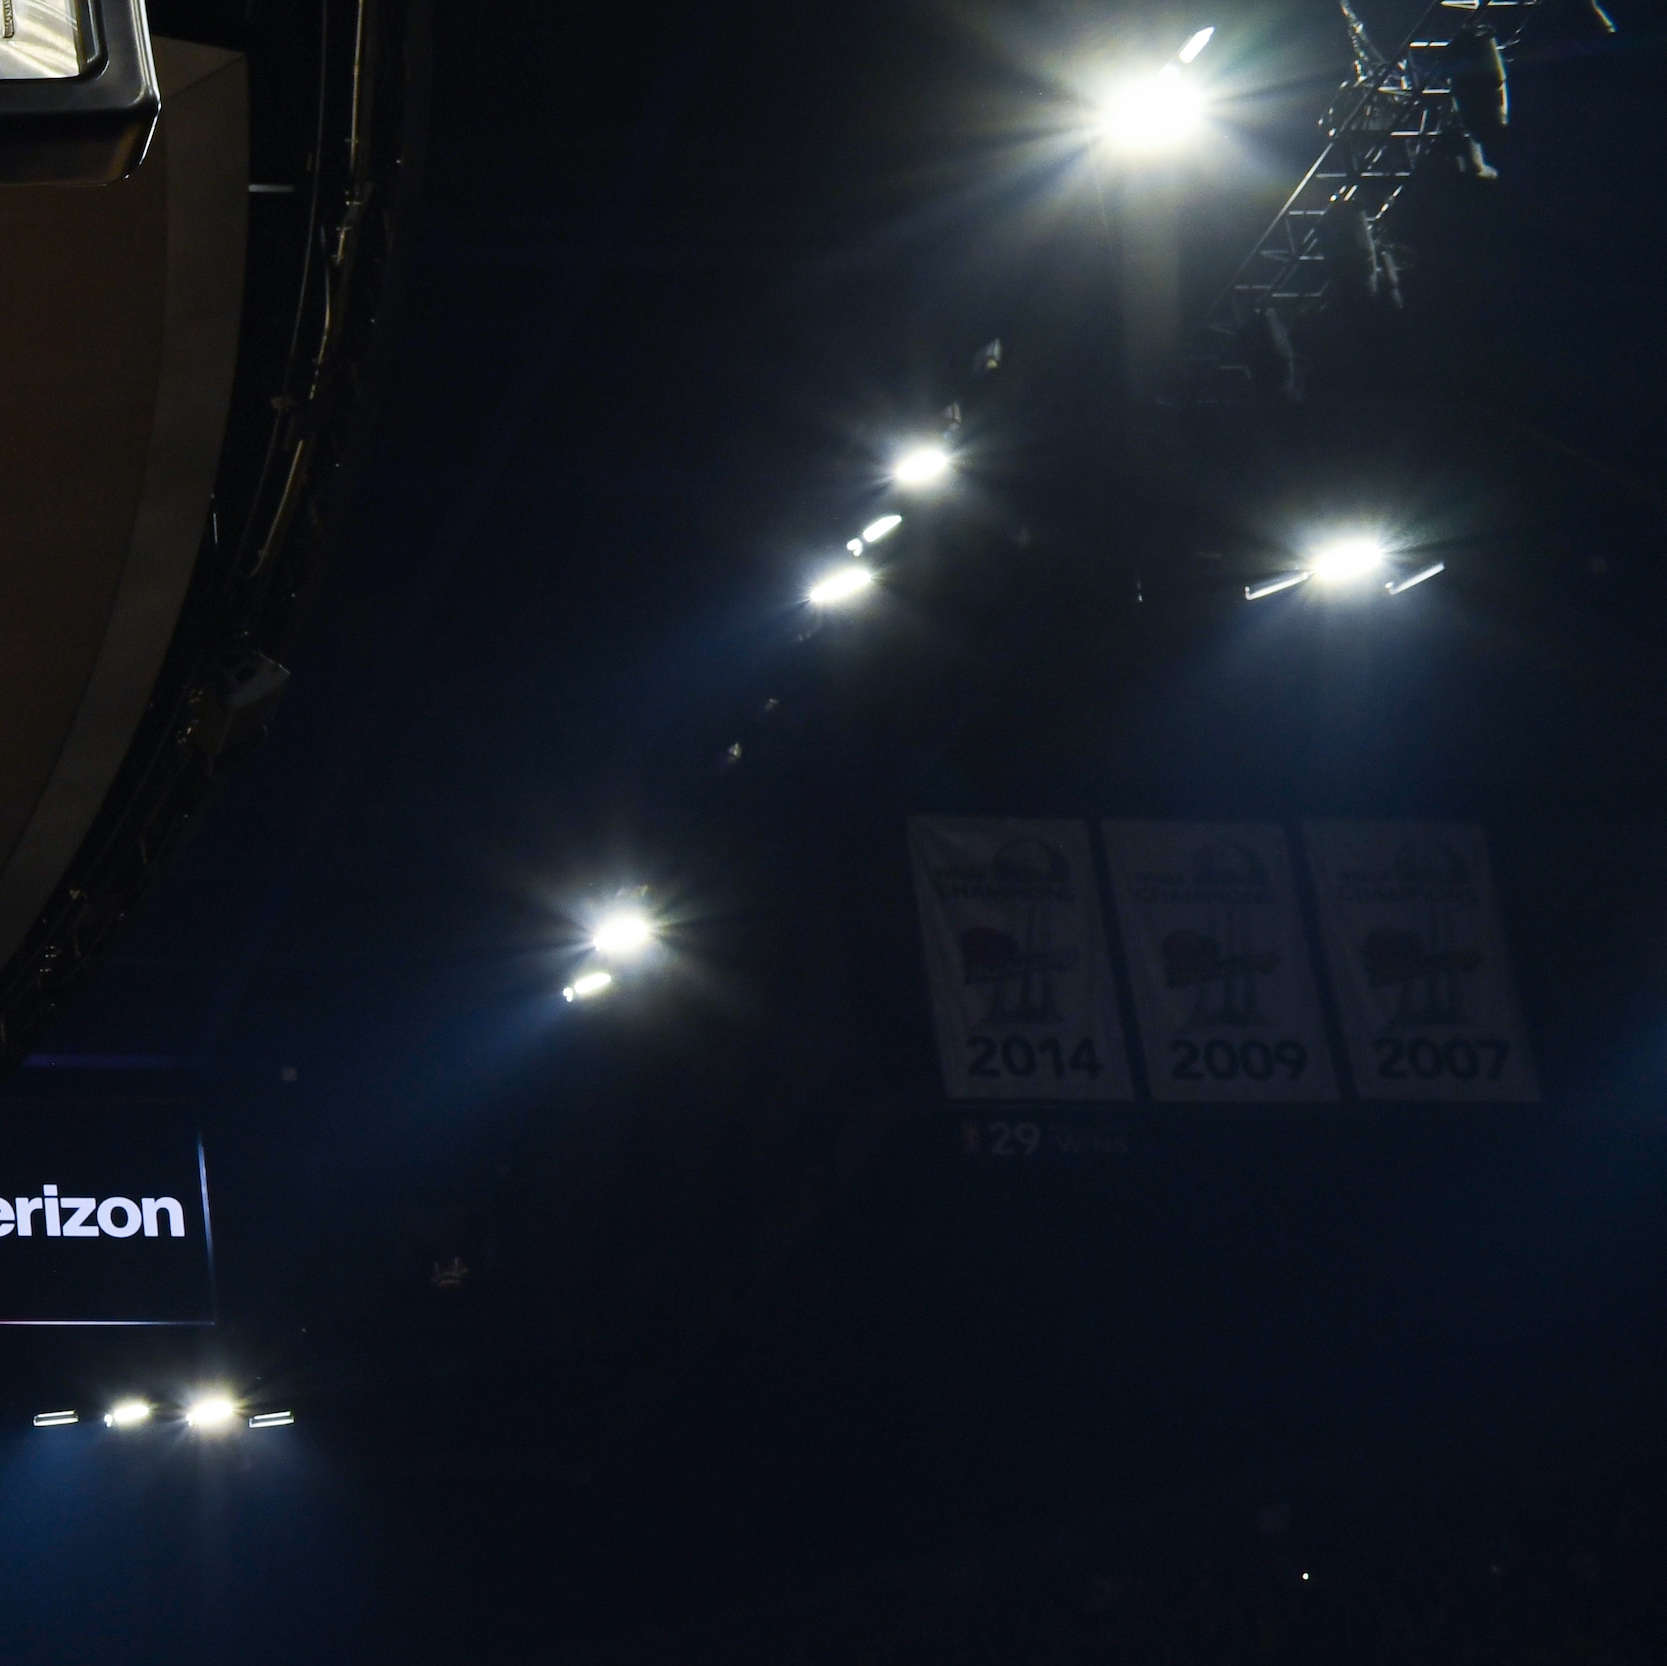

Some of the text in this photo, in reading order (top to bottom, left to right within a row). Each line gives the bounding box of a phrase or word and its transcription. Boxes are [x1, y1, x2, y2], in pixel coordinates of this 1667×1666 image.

[966, 1036, 1104, 1079] 2014
[1169, 1038, 1308, 1082] 2009
[1373, 1037, 1510, 1081] 2007
